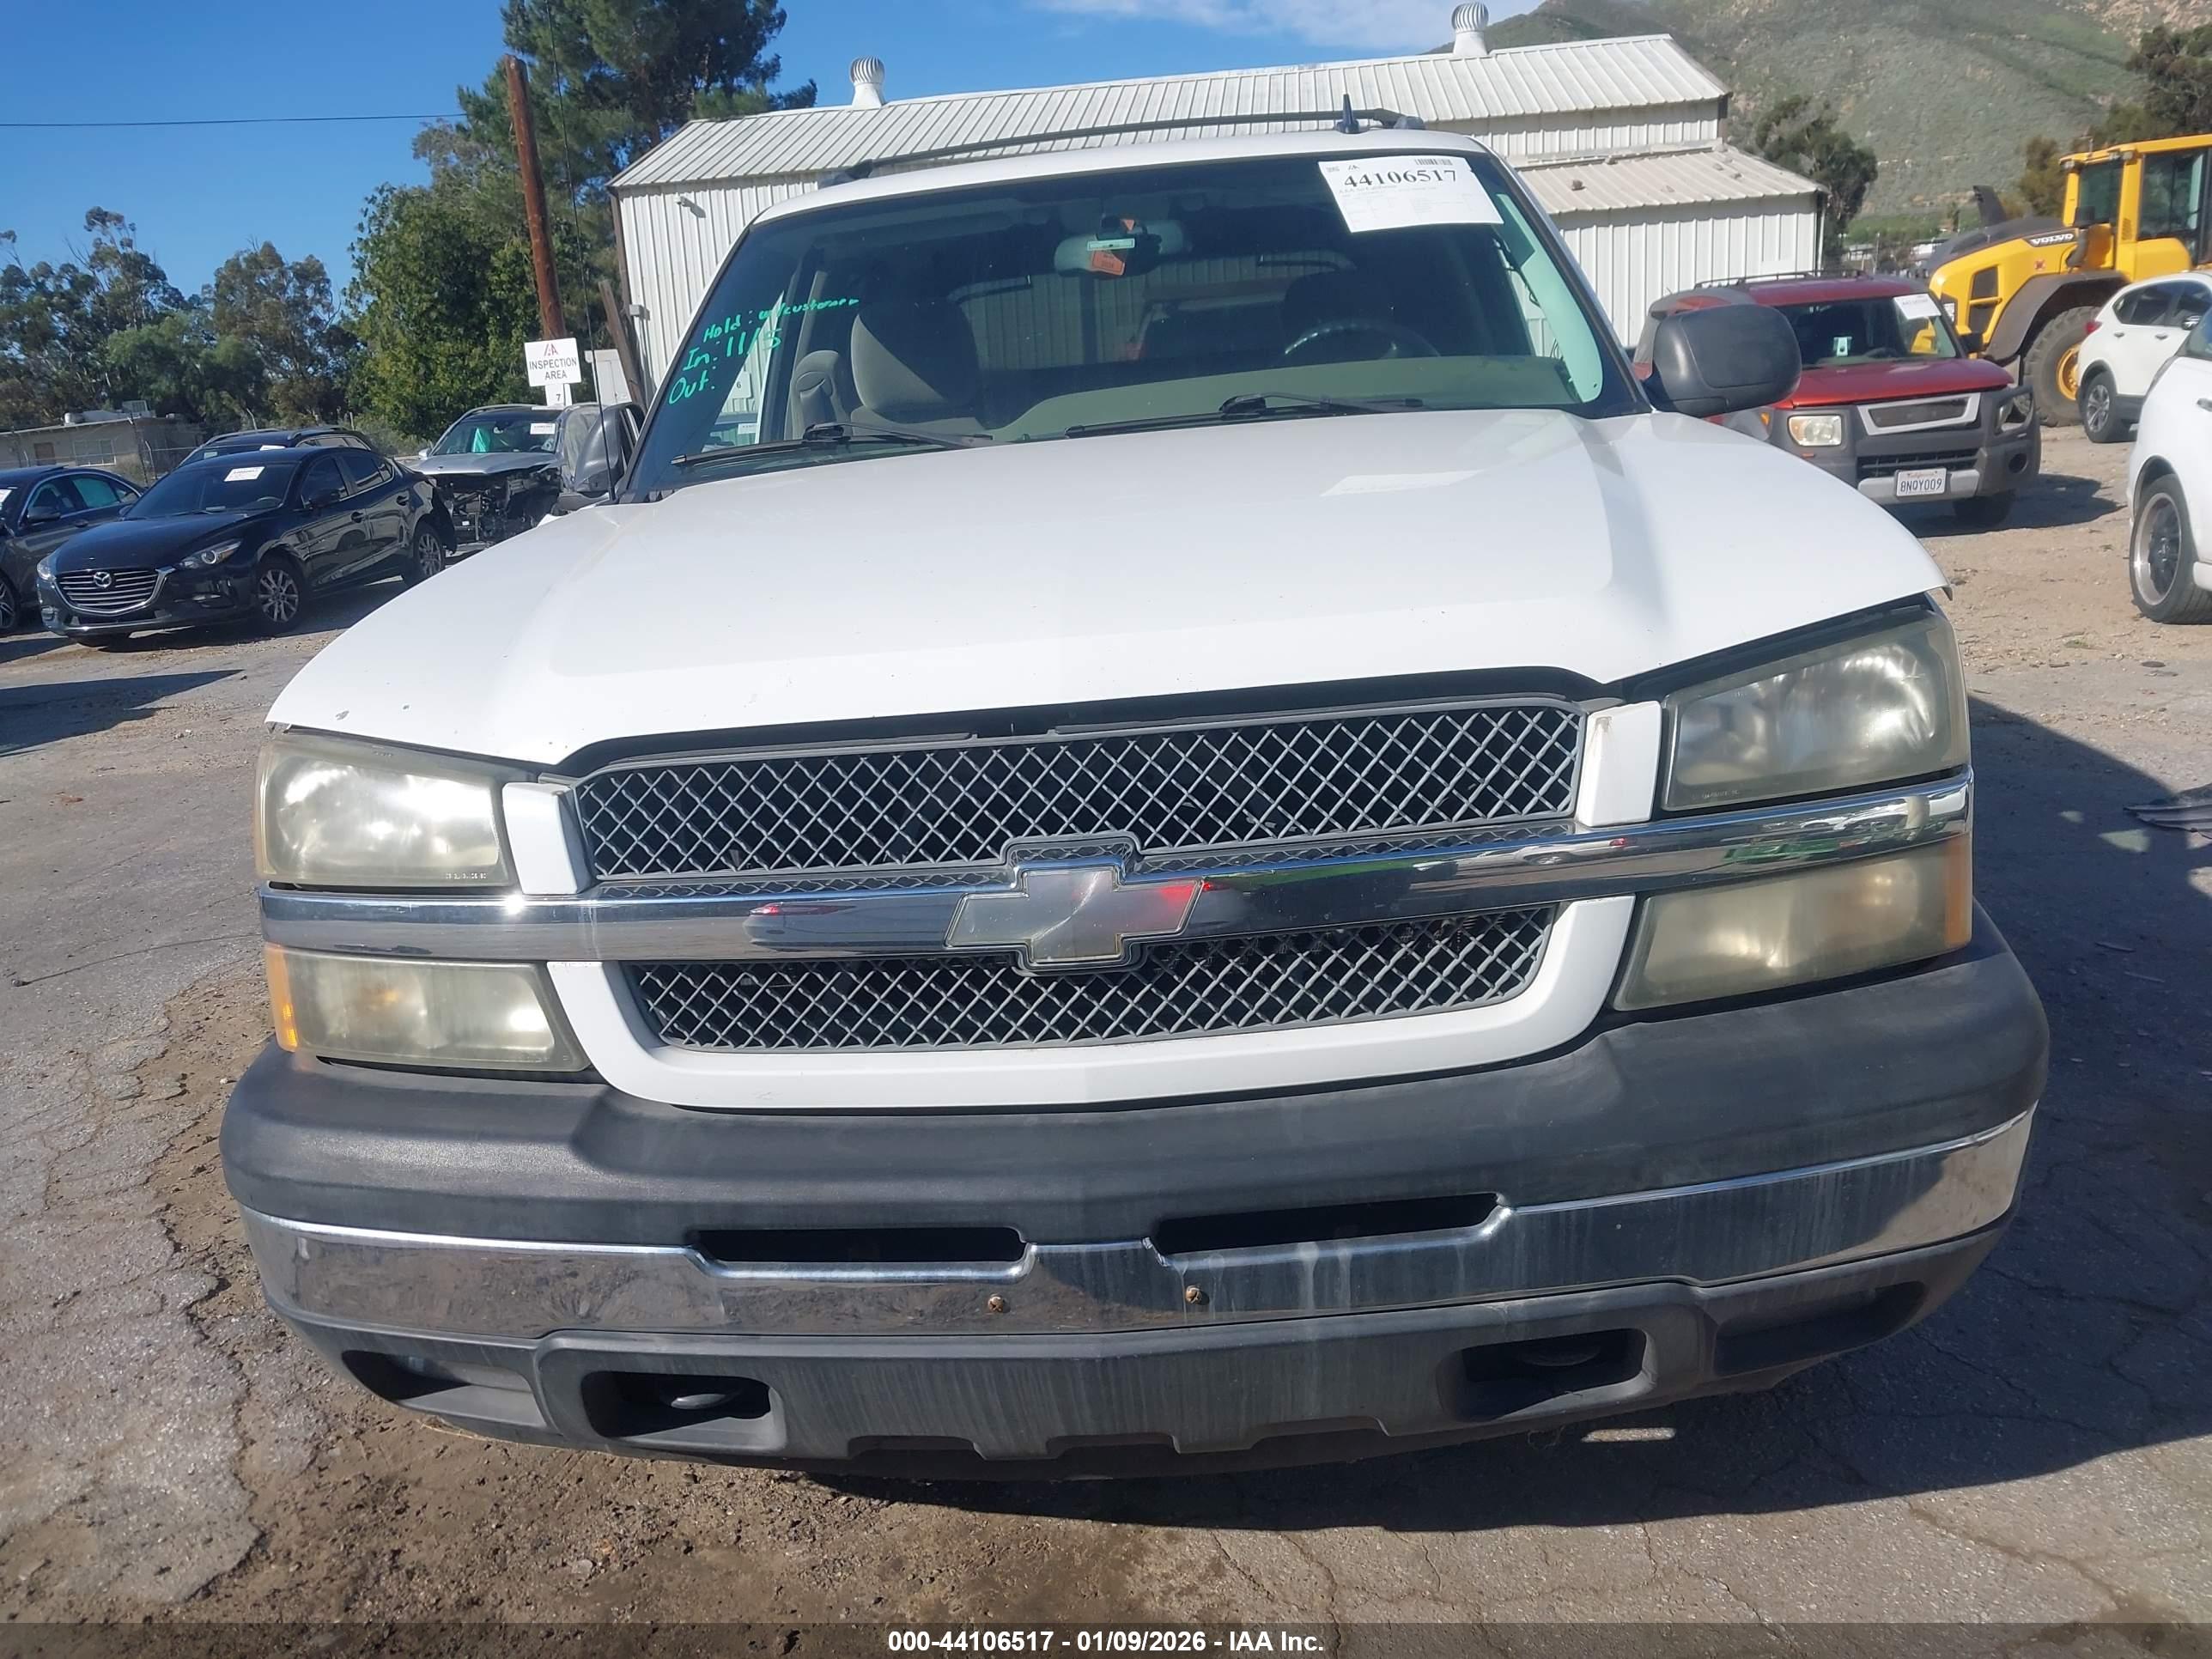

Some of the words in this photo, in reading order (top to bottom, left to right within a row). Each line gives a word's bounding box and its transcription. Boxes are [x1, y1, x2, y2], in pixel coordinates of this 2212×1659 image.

[1343, 169, 1457, 188] 44106517
[2030, 233, 2075, 246] VOLVO
[529, 356, 577, 370] INSPECTION
[544, 369, 568, 380] AREA
[556, 393, 562, 402] 7
